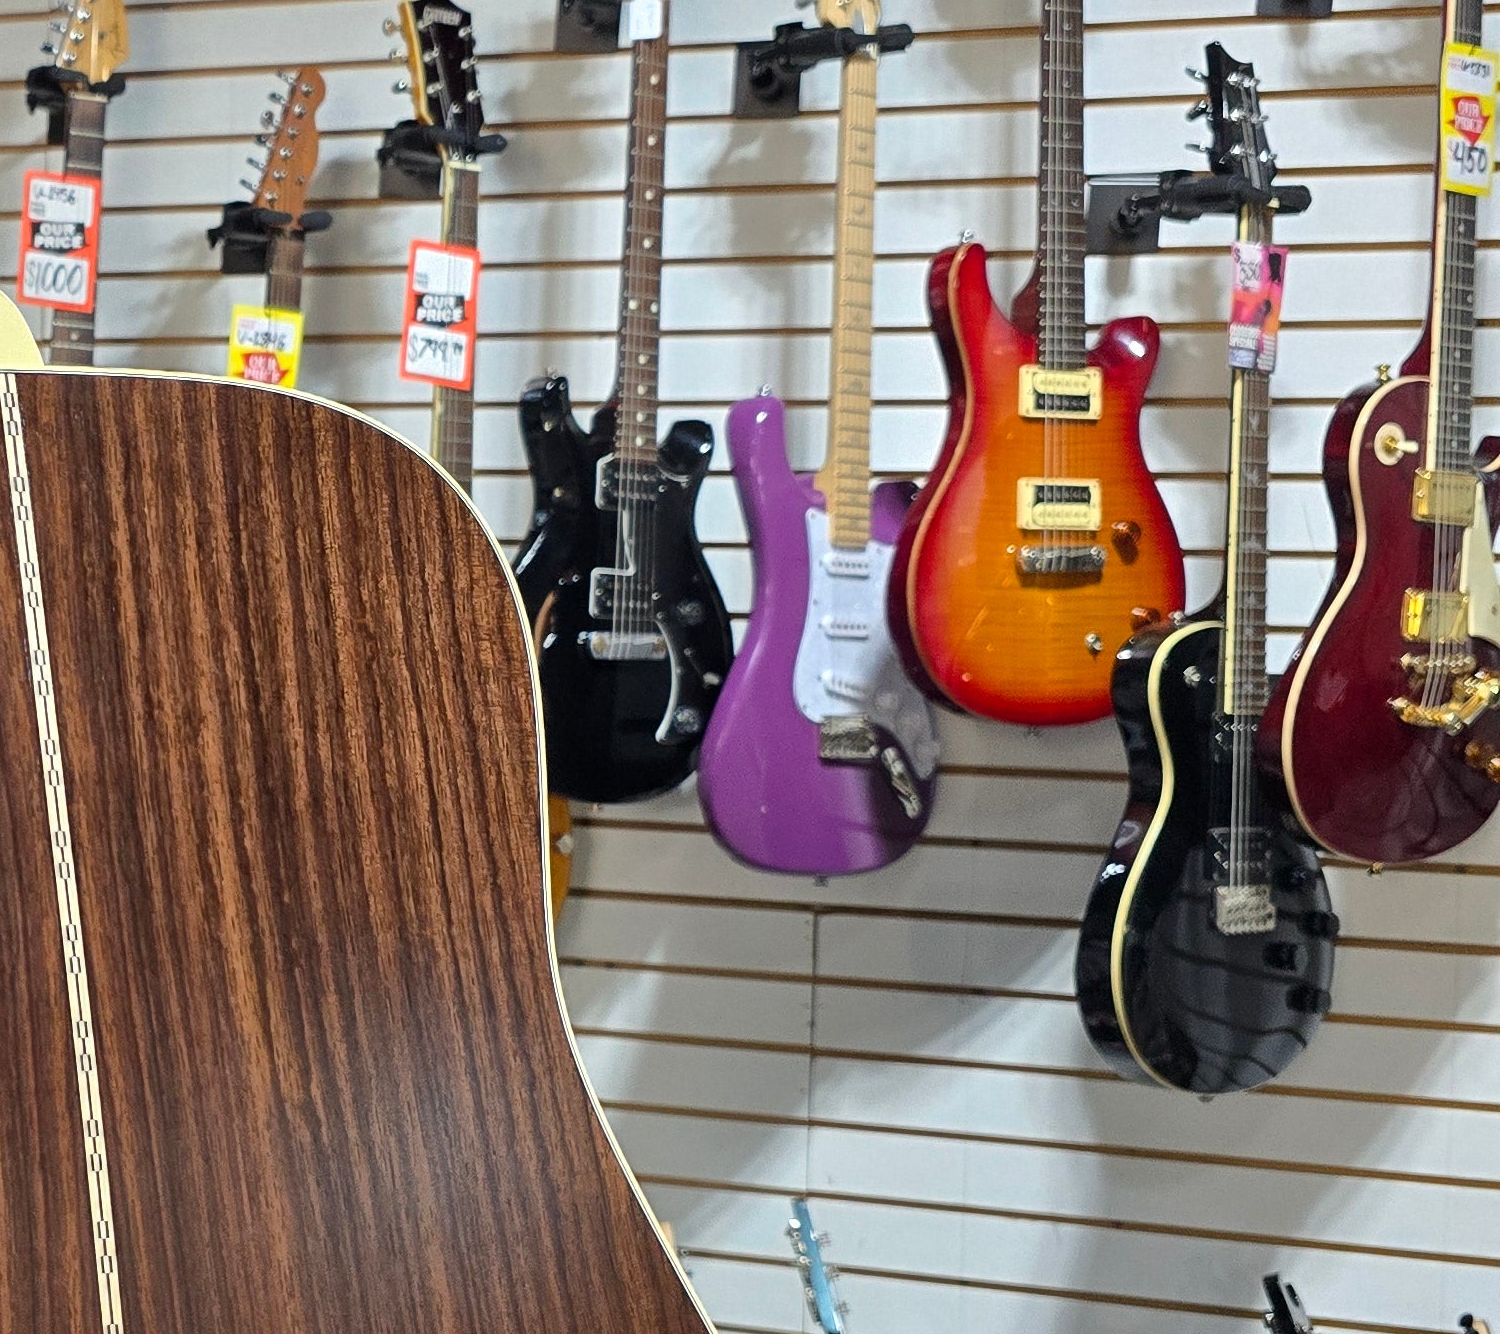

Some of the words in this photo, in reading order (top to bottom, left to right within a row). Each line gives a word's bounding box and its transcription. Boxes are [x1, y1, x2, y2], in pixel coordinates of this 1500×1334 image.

[39, 222, 77, 238] OUR
[33, 234, 84, 250] PRICE
[25, 260, 84, 296] $1000
[421, 294, 457, 310] OUR
[416, 306, 464, 323] PRICE
